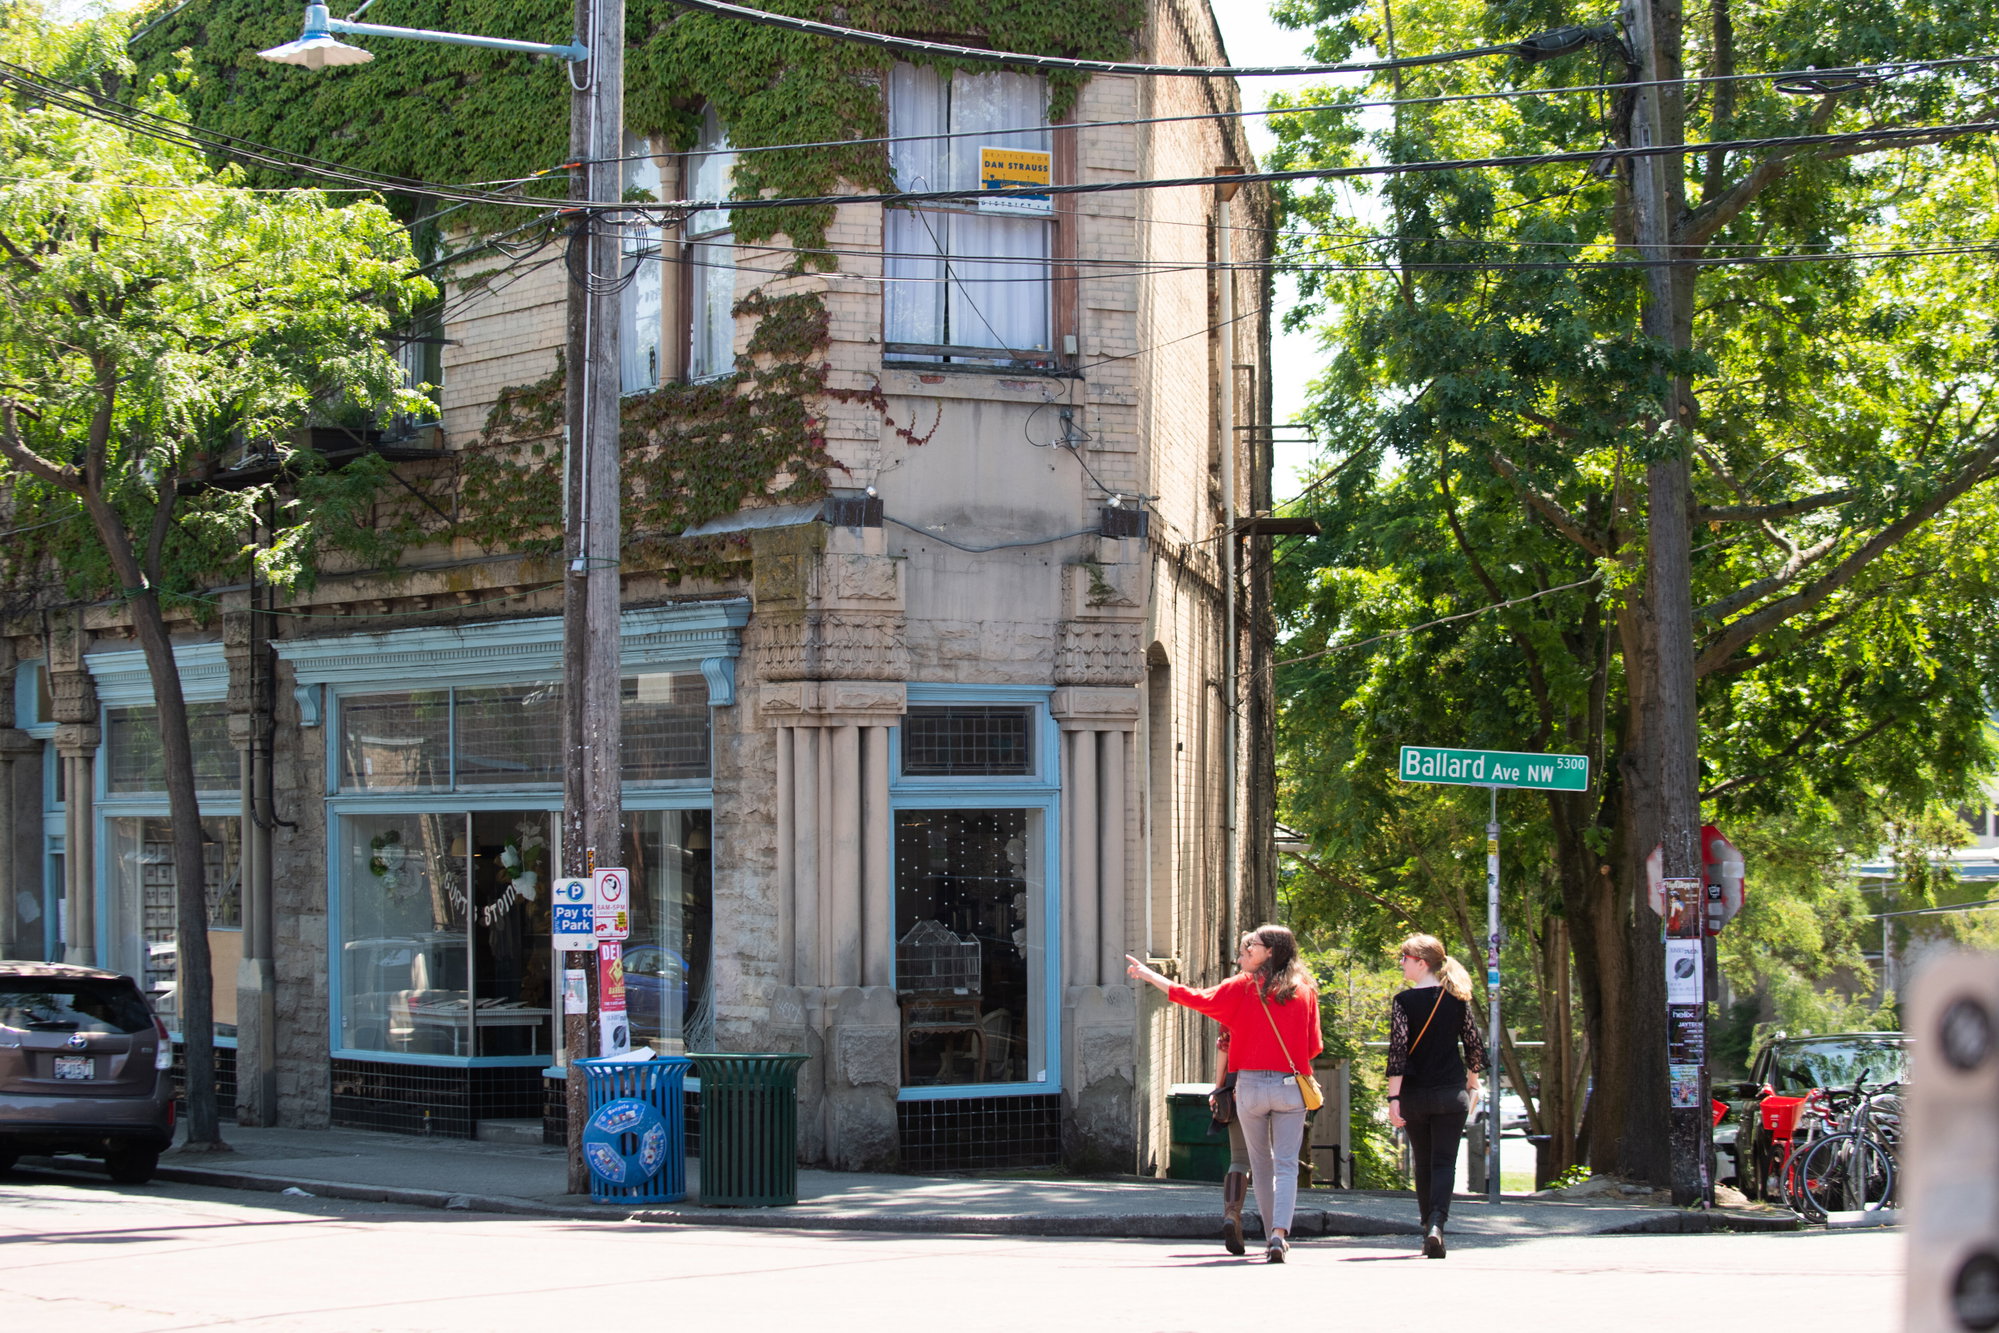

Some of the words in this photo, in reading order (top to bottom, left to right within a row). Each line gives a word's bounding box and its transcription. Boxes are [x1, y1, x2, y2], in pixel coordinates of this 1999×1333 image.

[984, 160, 1004, 168] DAN
[1008, 162, 1048, 172] STRAUSS
[1405, 750, 1485, 779] Ballard
[1491, 763, 1520, 781] Ave
[1527, 764, 1554, 783] NW
[1556, 757, 1585, 770] 5300
[556, 907, 578, 919] Pay
[582, 907, 594, 917] to
[562, 919, 590, 930] Park
